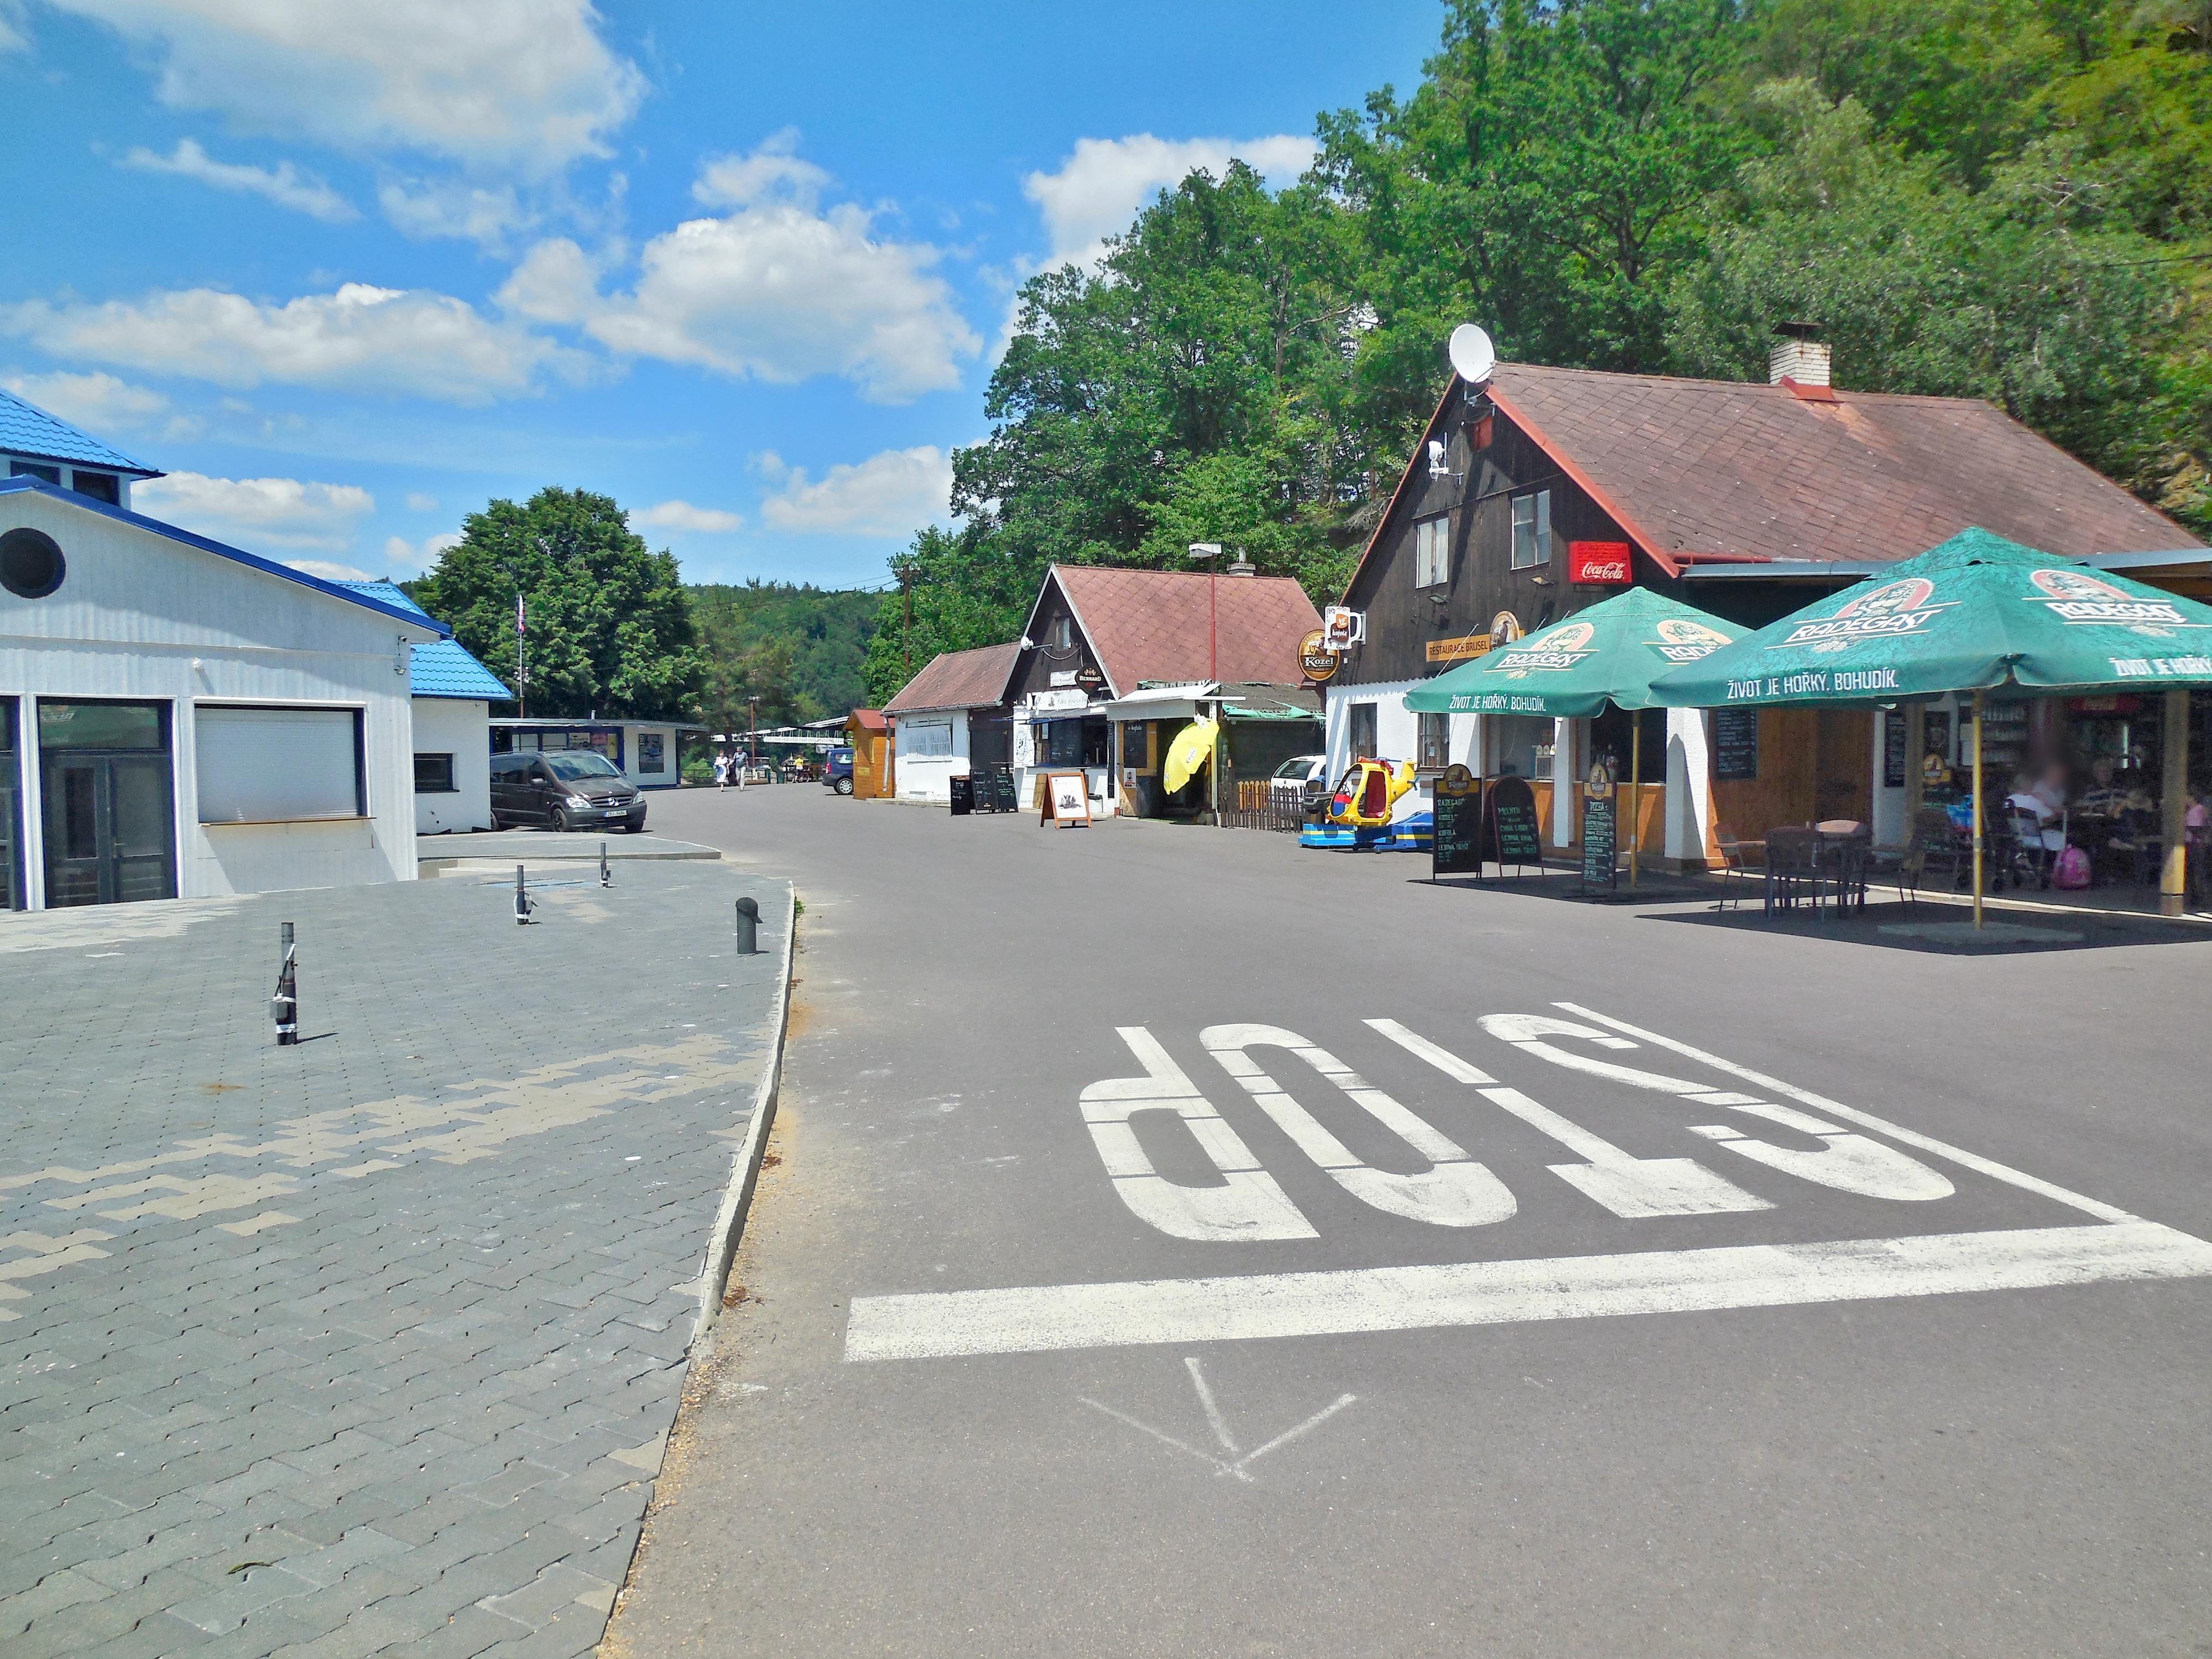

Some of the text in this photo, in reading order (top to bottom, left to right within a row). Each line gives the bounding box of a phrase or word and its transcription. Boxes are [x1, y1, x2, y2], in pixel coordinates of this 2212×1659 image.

[1582, 561, 1625, 580] Coca-Cola
[2044, 602, 2188, 623] RADEGAST
[1332, 629, 1347, 638] kofola
[1784, 609, 1943, 643] RADEGAST
[1429, 640, 1488, 656] RESTAURACE BRUSEL
[1305, 656, 1334, 667] Kozel
[1495, 653, 1588, 668] RADEGAST
[1727, 667, 1900, 699] ŽIVOT JE HOŘKÝ. BOHUDÍK.
[1448, 693, 1547, 712] ŽIVOT JE HOŘKÝ. BOHUDÍK.
[1079, 1013, 1955, 1241] STOP
